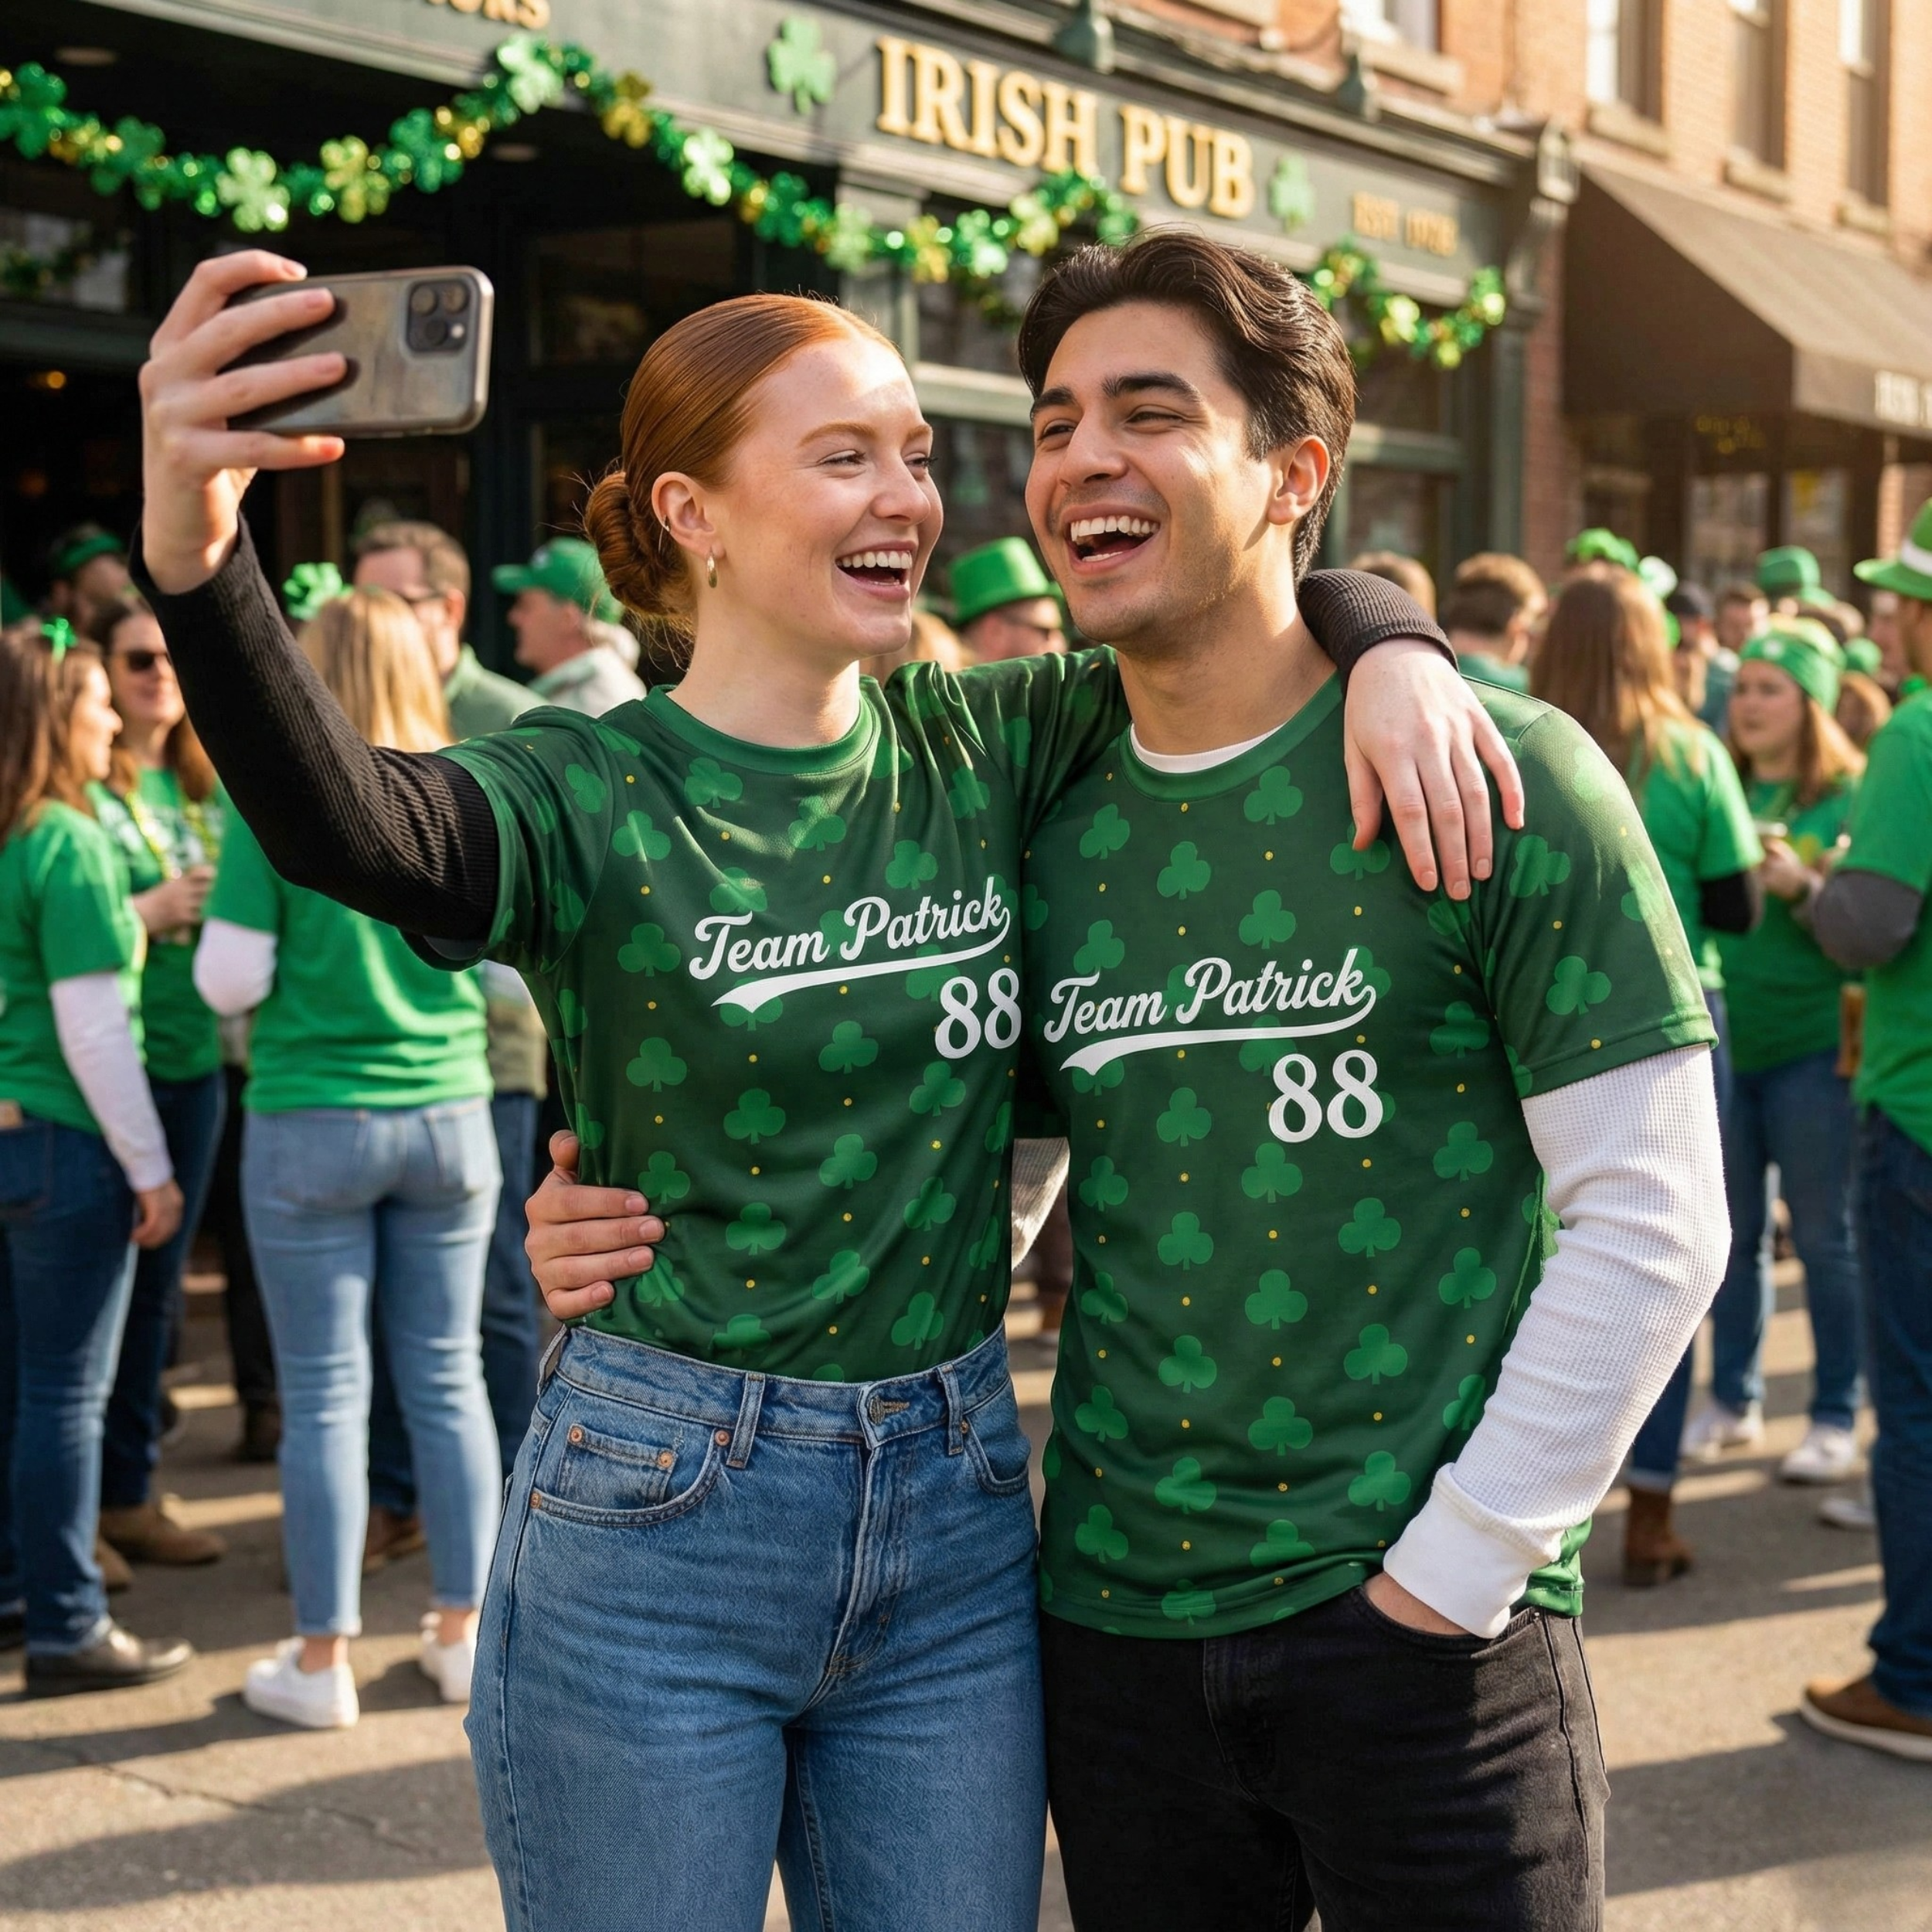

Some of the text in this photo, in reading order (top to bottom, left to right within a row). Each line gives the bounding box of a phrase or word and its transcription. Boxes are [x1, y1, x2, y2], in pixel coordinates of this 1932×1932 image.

[876, 36, 1255, 219] IRISH PUB
[689, 876, 1009, 980] Team Patrick
[934, 968, 1022, 1059] 88
[1043, 948, 1366, 1043] Team Patrick
[1268, 1049, 1383, 1143] 88
